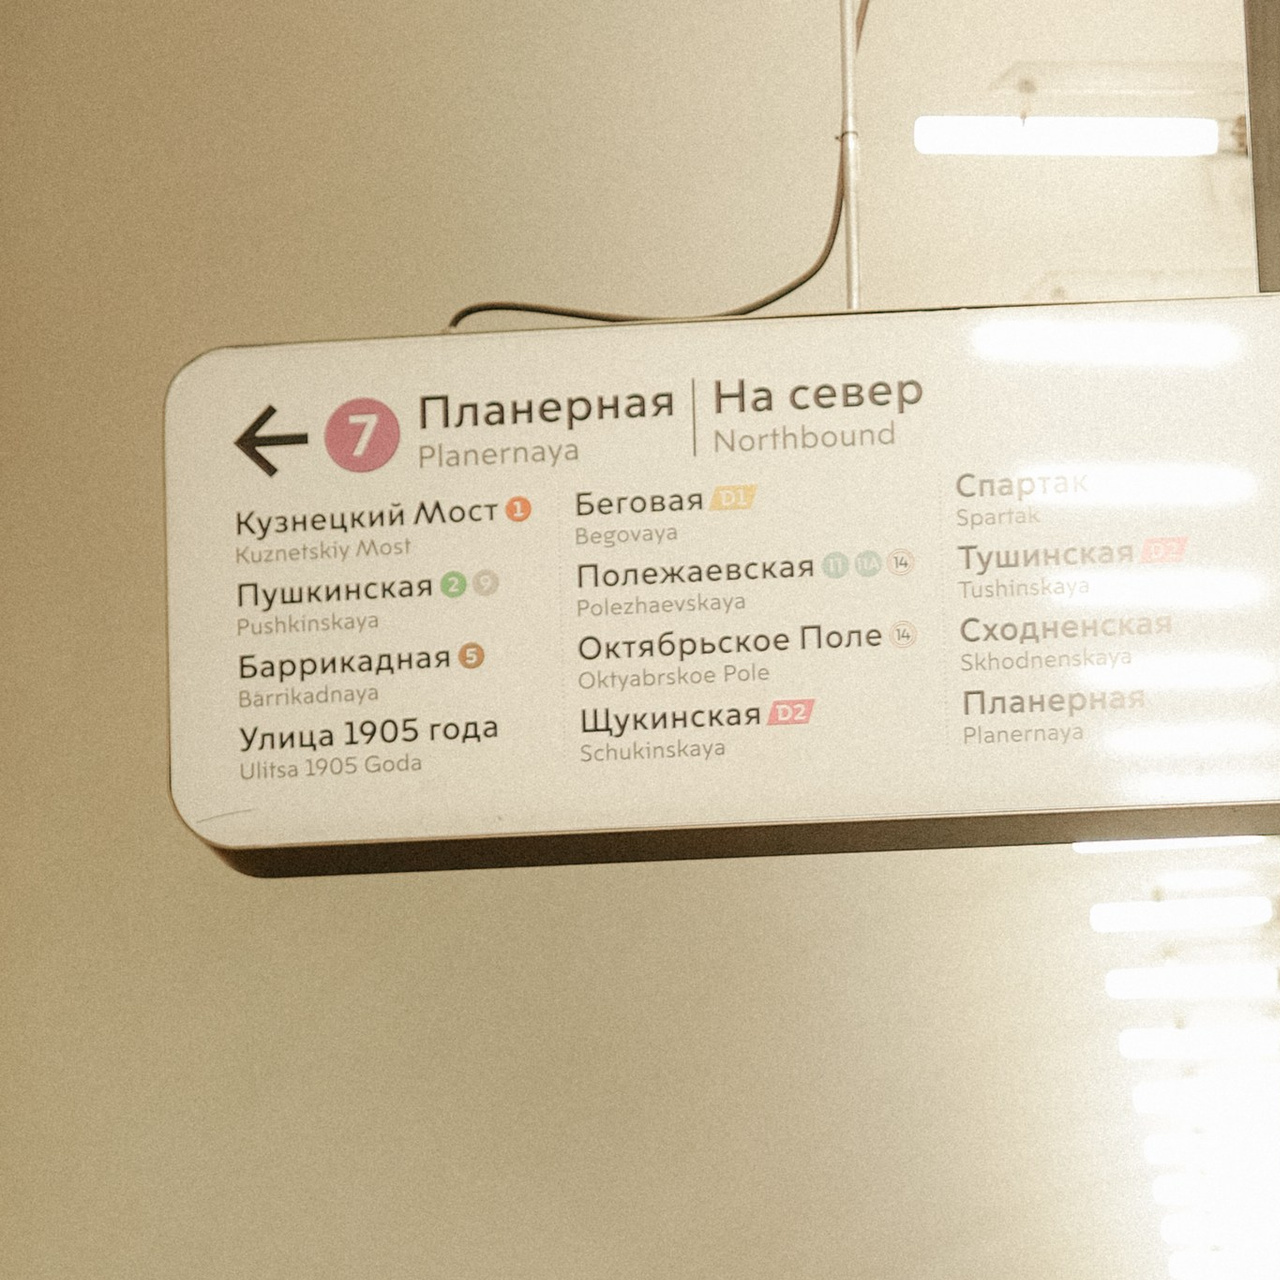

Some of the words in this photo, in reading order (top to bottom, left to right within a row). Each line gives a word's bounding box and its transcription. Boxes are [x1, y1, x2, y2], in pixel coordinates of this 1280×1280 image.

[419, 389, 674, 430] Планерная
[714, 378, 774, 414] На
[789, 378, 923, 414] север
[347, 413, 378, 457] 7
[714, 421, 896, 453] Northbound
[419, 442, 579, 468] Planernaya
[956, 473, 1088, 501] Спартак
[576, 492, 703, 516] Беговая
[236, 502, 405, 539] Кузнецкий
[413, 502, 499, 527] Мост
[956, 507, 1040, 529] Spartak
[575, 526, 678, 547] Begovaya
[236, 541, 350, 565] Kuznetskiy
[355, 538, 412, 557] Most
[958, 543, 1134, 575] Тушинская
[578, 560, 814, 588] Полежаевская
[237, 578, 432, 612] Пушкинская
[958, 578, 1089, 599] Tushinskaya
[577, 594, 746, 617] Polezhaevskaya
[237, 613, 379, 636] Pushkinskaya
[960, 615, 1173, 643] Сходненская
[579, 631, 789, 661] Октябрьское
[800, 625, 882, 650] Поле
[239, 649, 451, 683] Баррикадная
[961, 649, 1132, 671] Skhodnenskaya
[578, 665, 716, 691] Oktyabrskoe
[724, 664, 770, 682] Pole
[239, 685, 379, 708] Barrikadnaya
[963, 689, 1145, 716] Планерная
[581, 706, 760, 737] Щукинская
[963, 725, 1083, 744] Planernaya
[240, 724, 334, 753] Улица
[344, 719, 419, 746] 1905
[430, 719, 499, 743] года
[580, 741, 725, 762] Schukinskaya
[240, 760, 299, 780] Ulitsa
[305, 758, 358, 776] 1905
[364, 755, 422, 773] Goda
